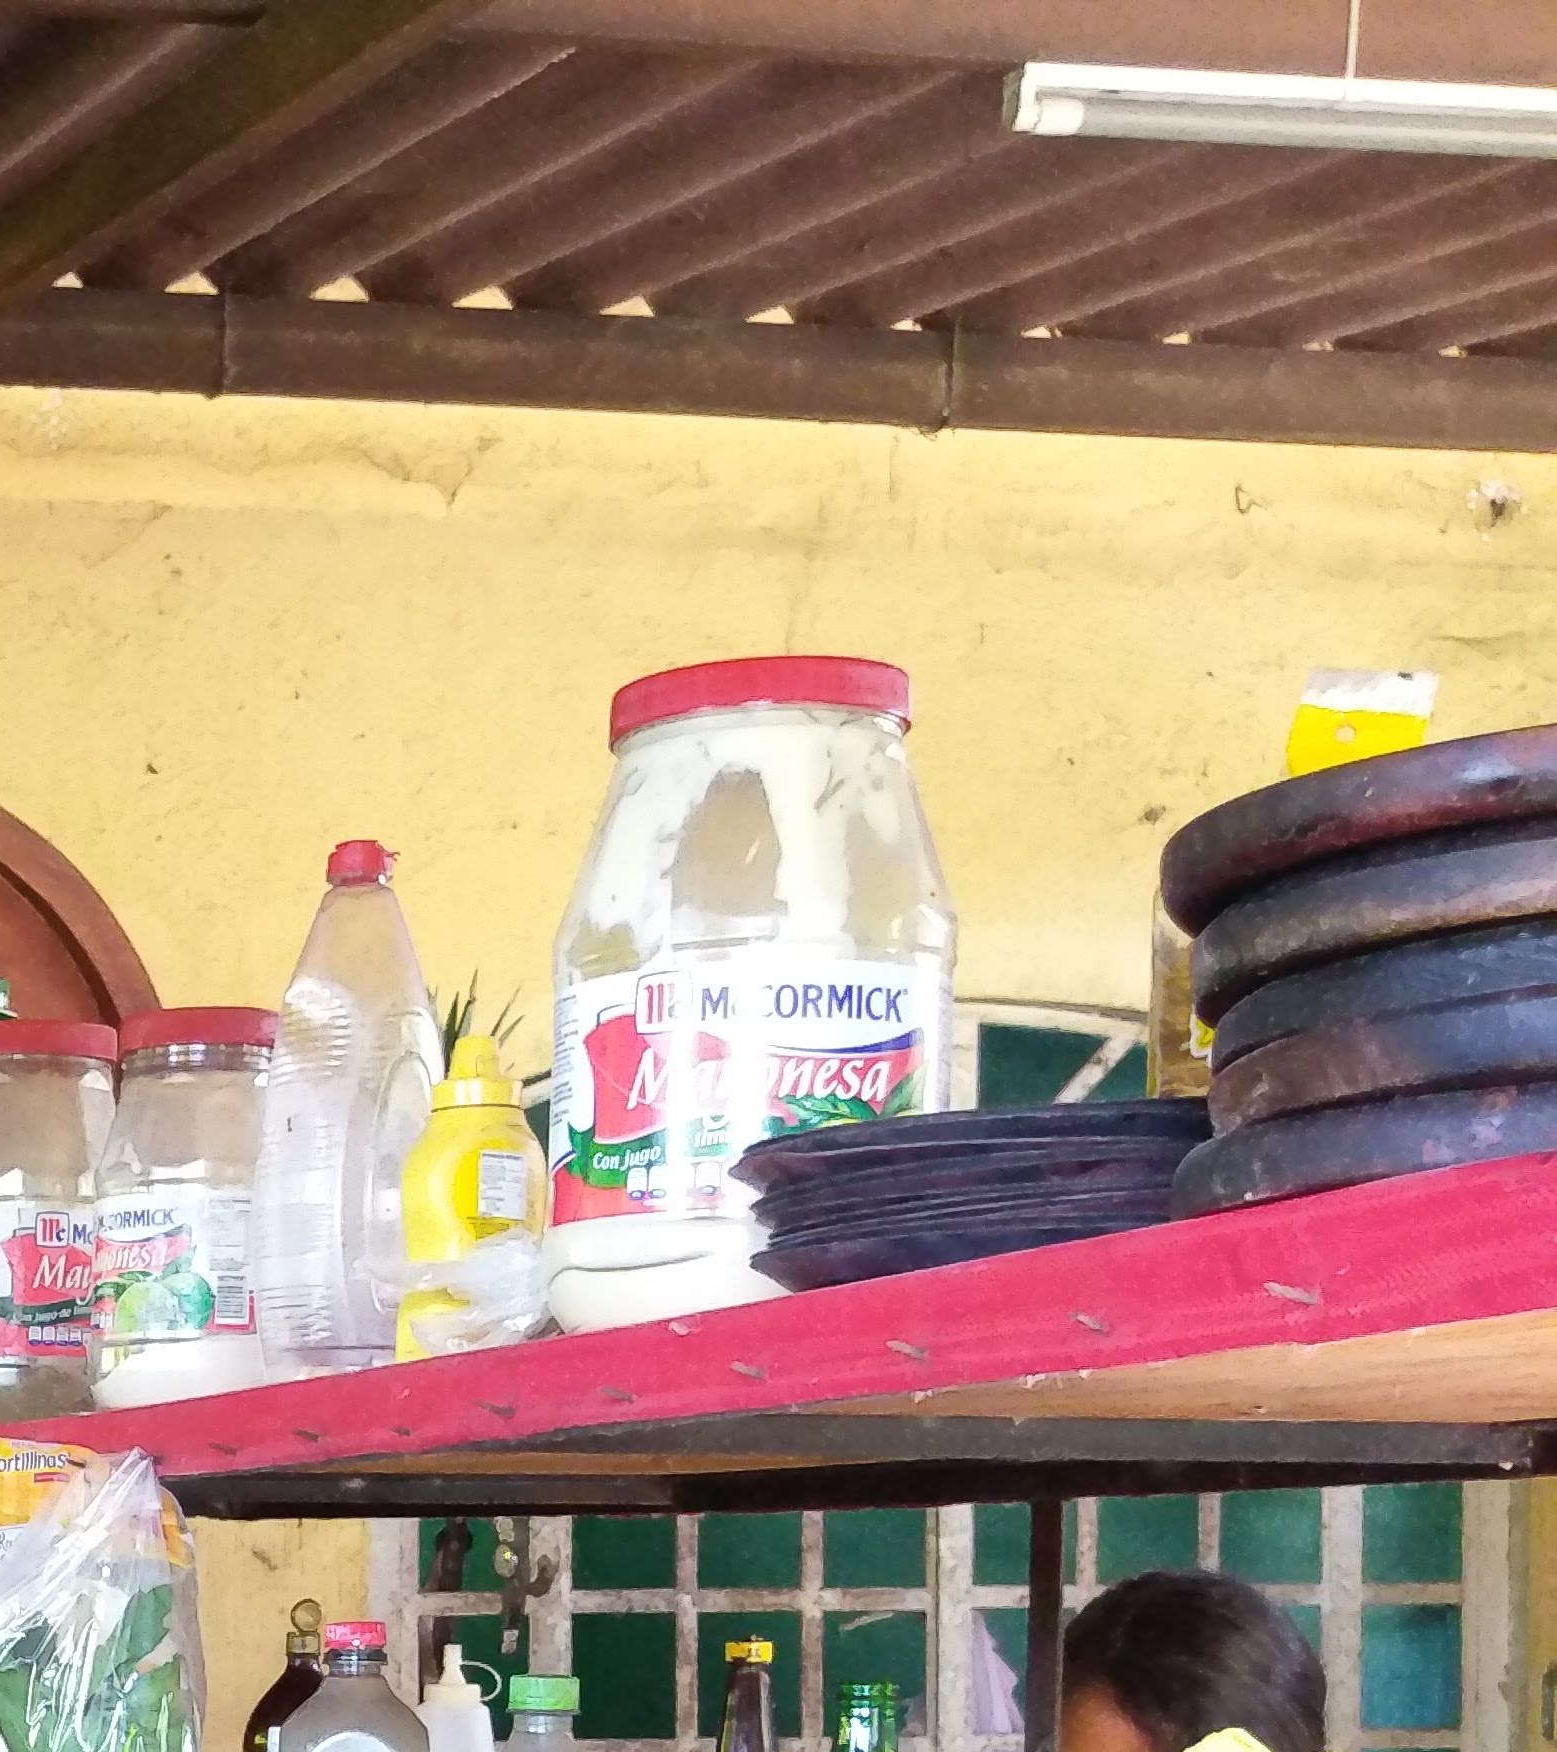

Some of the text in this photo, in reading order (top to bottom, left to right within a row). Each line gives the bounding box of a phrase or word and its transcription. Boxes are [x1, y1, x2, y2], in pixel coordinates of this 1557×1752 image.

[700, 983, 902, 1023] MORMICK
[627, 1046, 892, 1131] Manesa
[593, 1151, 619, 1170] Con
